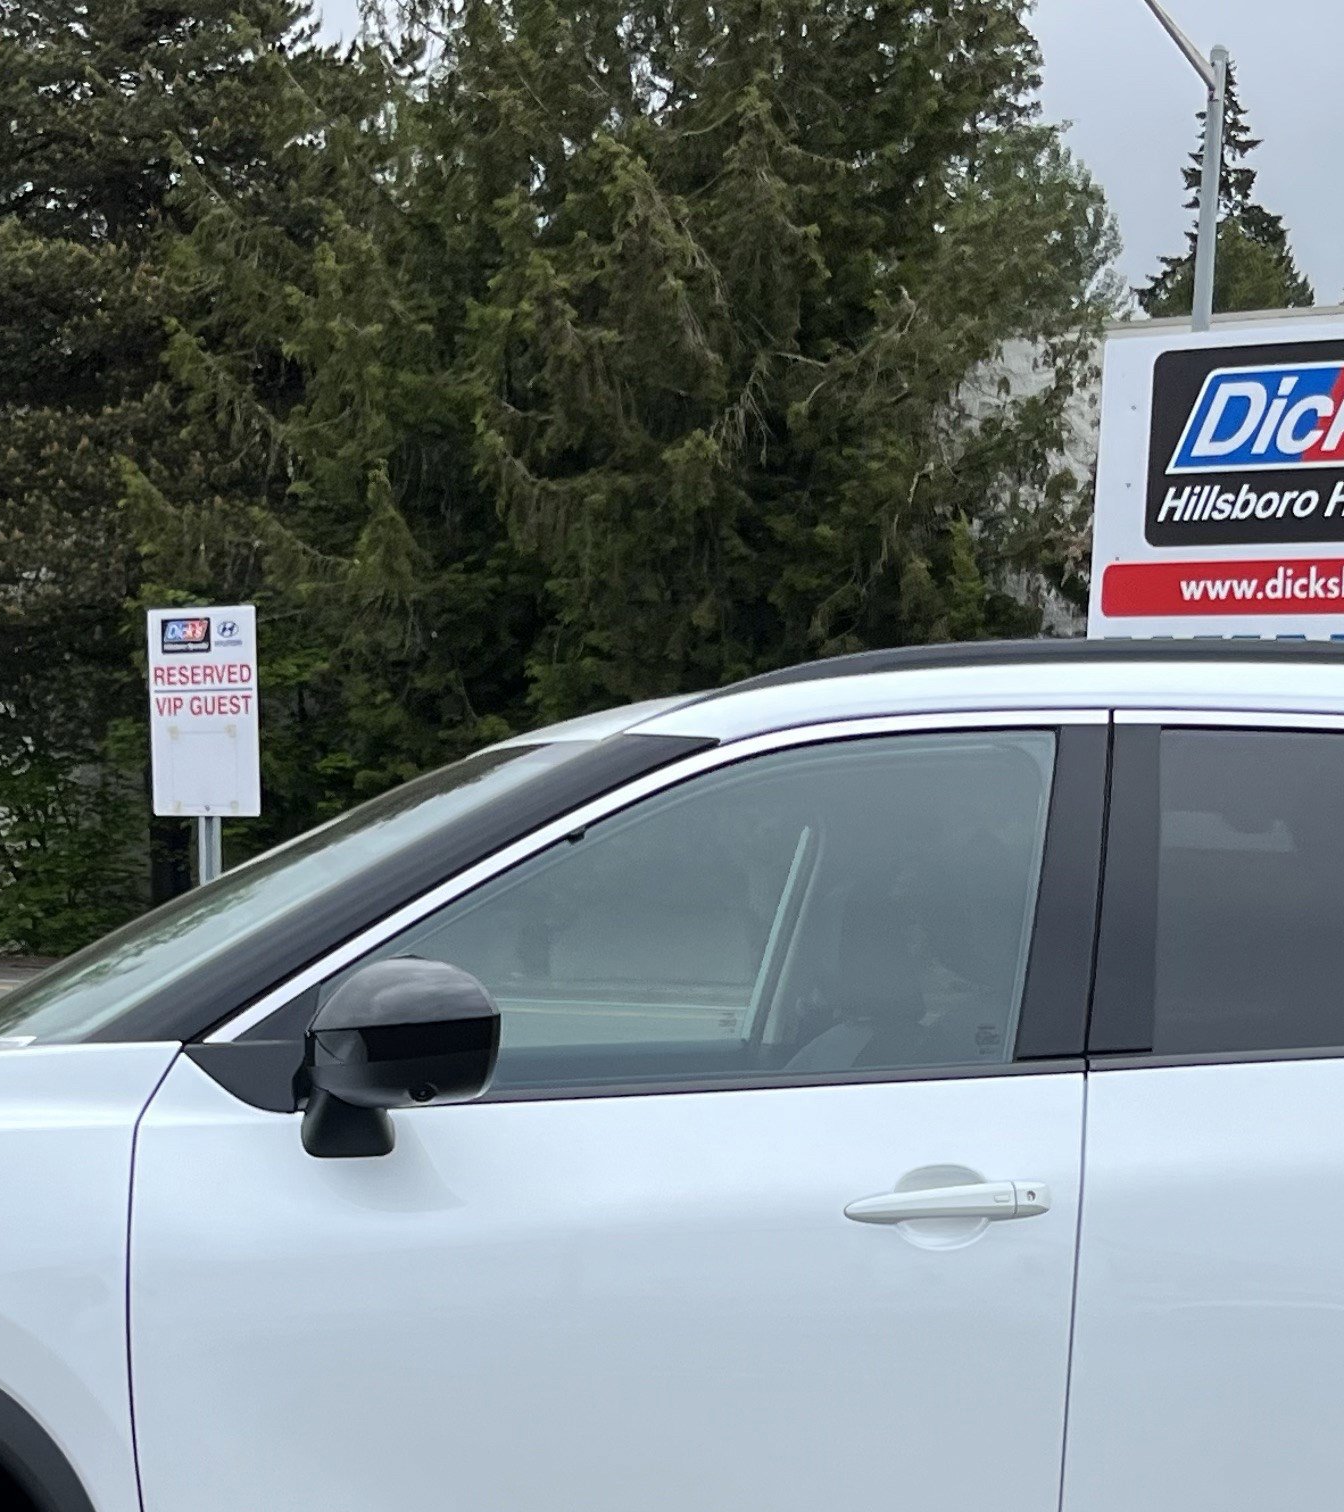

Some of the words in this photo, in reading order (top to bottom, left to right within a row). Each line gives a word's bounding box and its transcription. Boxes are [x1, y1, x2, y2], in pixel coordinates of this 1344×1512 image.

[1156, 483, 1320, 523] Hillsboro
[154, 663, 252, 686] RESERVED
[156, 696, 183, 717] VIP
[189, 695, 252, 717] GUEST
